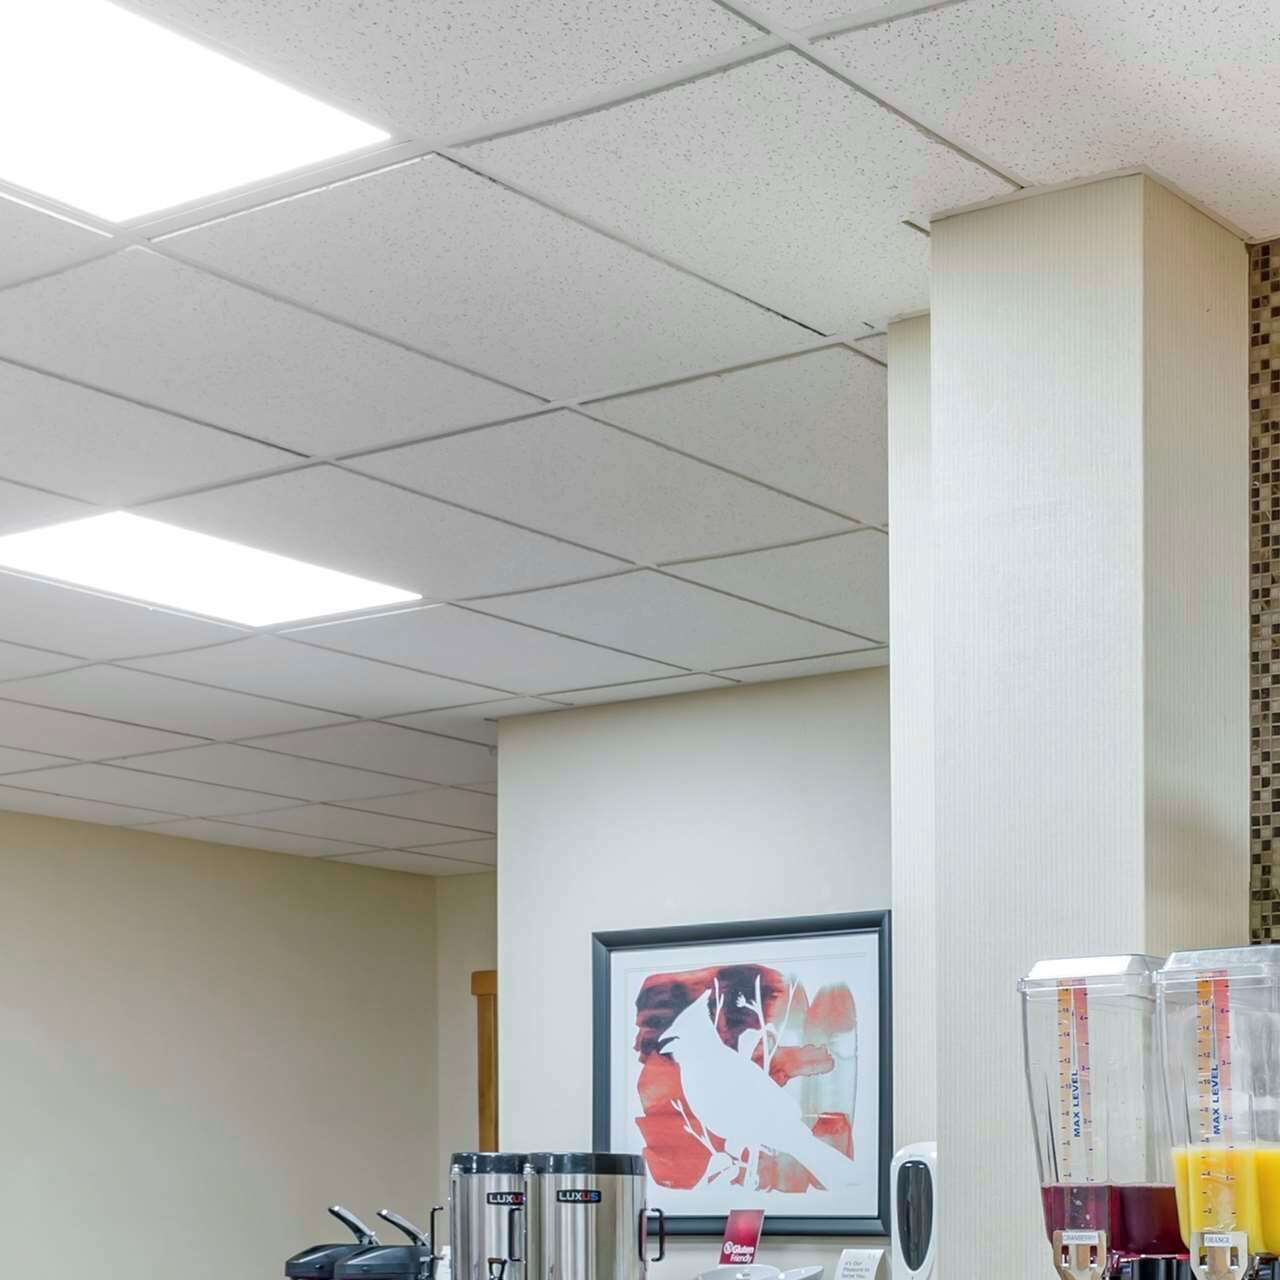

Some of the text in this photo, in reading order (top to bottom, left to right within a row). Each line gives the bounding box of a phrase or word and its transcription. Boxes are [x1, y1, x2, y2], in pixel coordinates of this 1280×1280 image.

[1072, 1069, 1081, 1137] MAX LEVEL
[1211, 1064, 1221, 1135] MAX LEVEL
[489, 1194, 524, 1203] LUXU
[559, 1192, 599, 1201] LUXUS
[732, 1244, 755, 1254] Gluten
